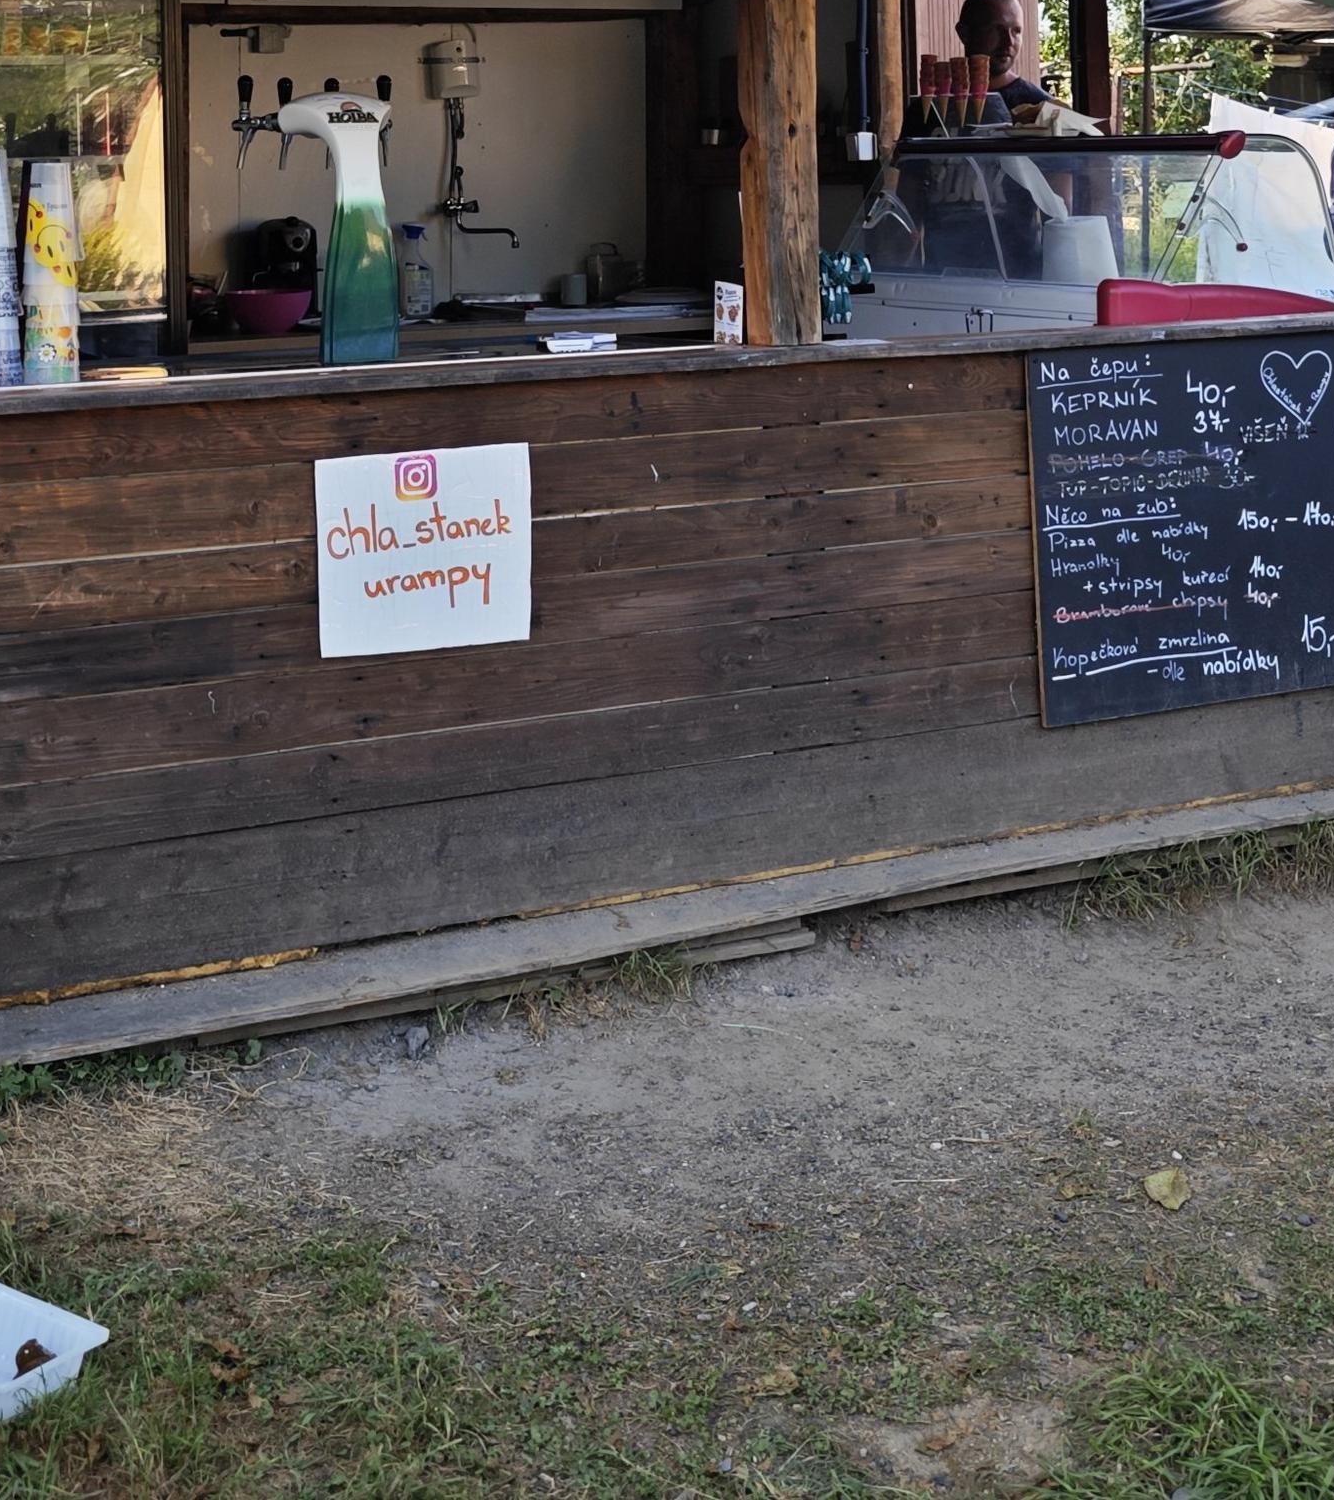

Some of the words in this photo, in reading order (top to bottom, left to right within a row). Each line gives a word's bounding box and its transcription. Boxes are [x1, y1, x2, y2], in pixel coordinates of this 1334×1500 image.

[326, 111, 379, 124] HOLBA
[1040, 362, 1070, 384] Na
[1051, 378, 1158, 416] KEPRNÍK
[1054, 418, 1158, 446] MORAVAN
[326, 498, 512, 560] chla_stanek
[1045, 504, 1087, 525] Něco
[1101, 505, 1121, 517] na
[1048, 531, 1096, 552] Pizza
[1116, 528, 1140, 543] dle
[1152, 521, 1208, 540] nabídky
[1051, 553, 1120, 578] Hranolky
[364, 562, 491, 609] urampy
[1098, 576, 1163, 598] stripsy
[1182, 565, 1231, 586] kuřecí
[1172, 591, 1228, 620] chipsy
[1053, 637, 1139, 674] Kopečková
[1158, 629, 1230, 650] zmrzlina
[1203, 650, 1280, 680] nabídky
